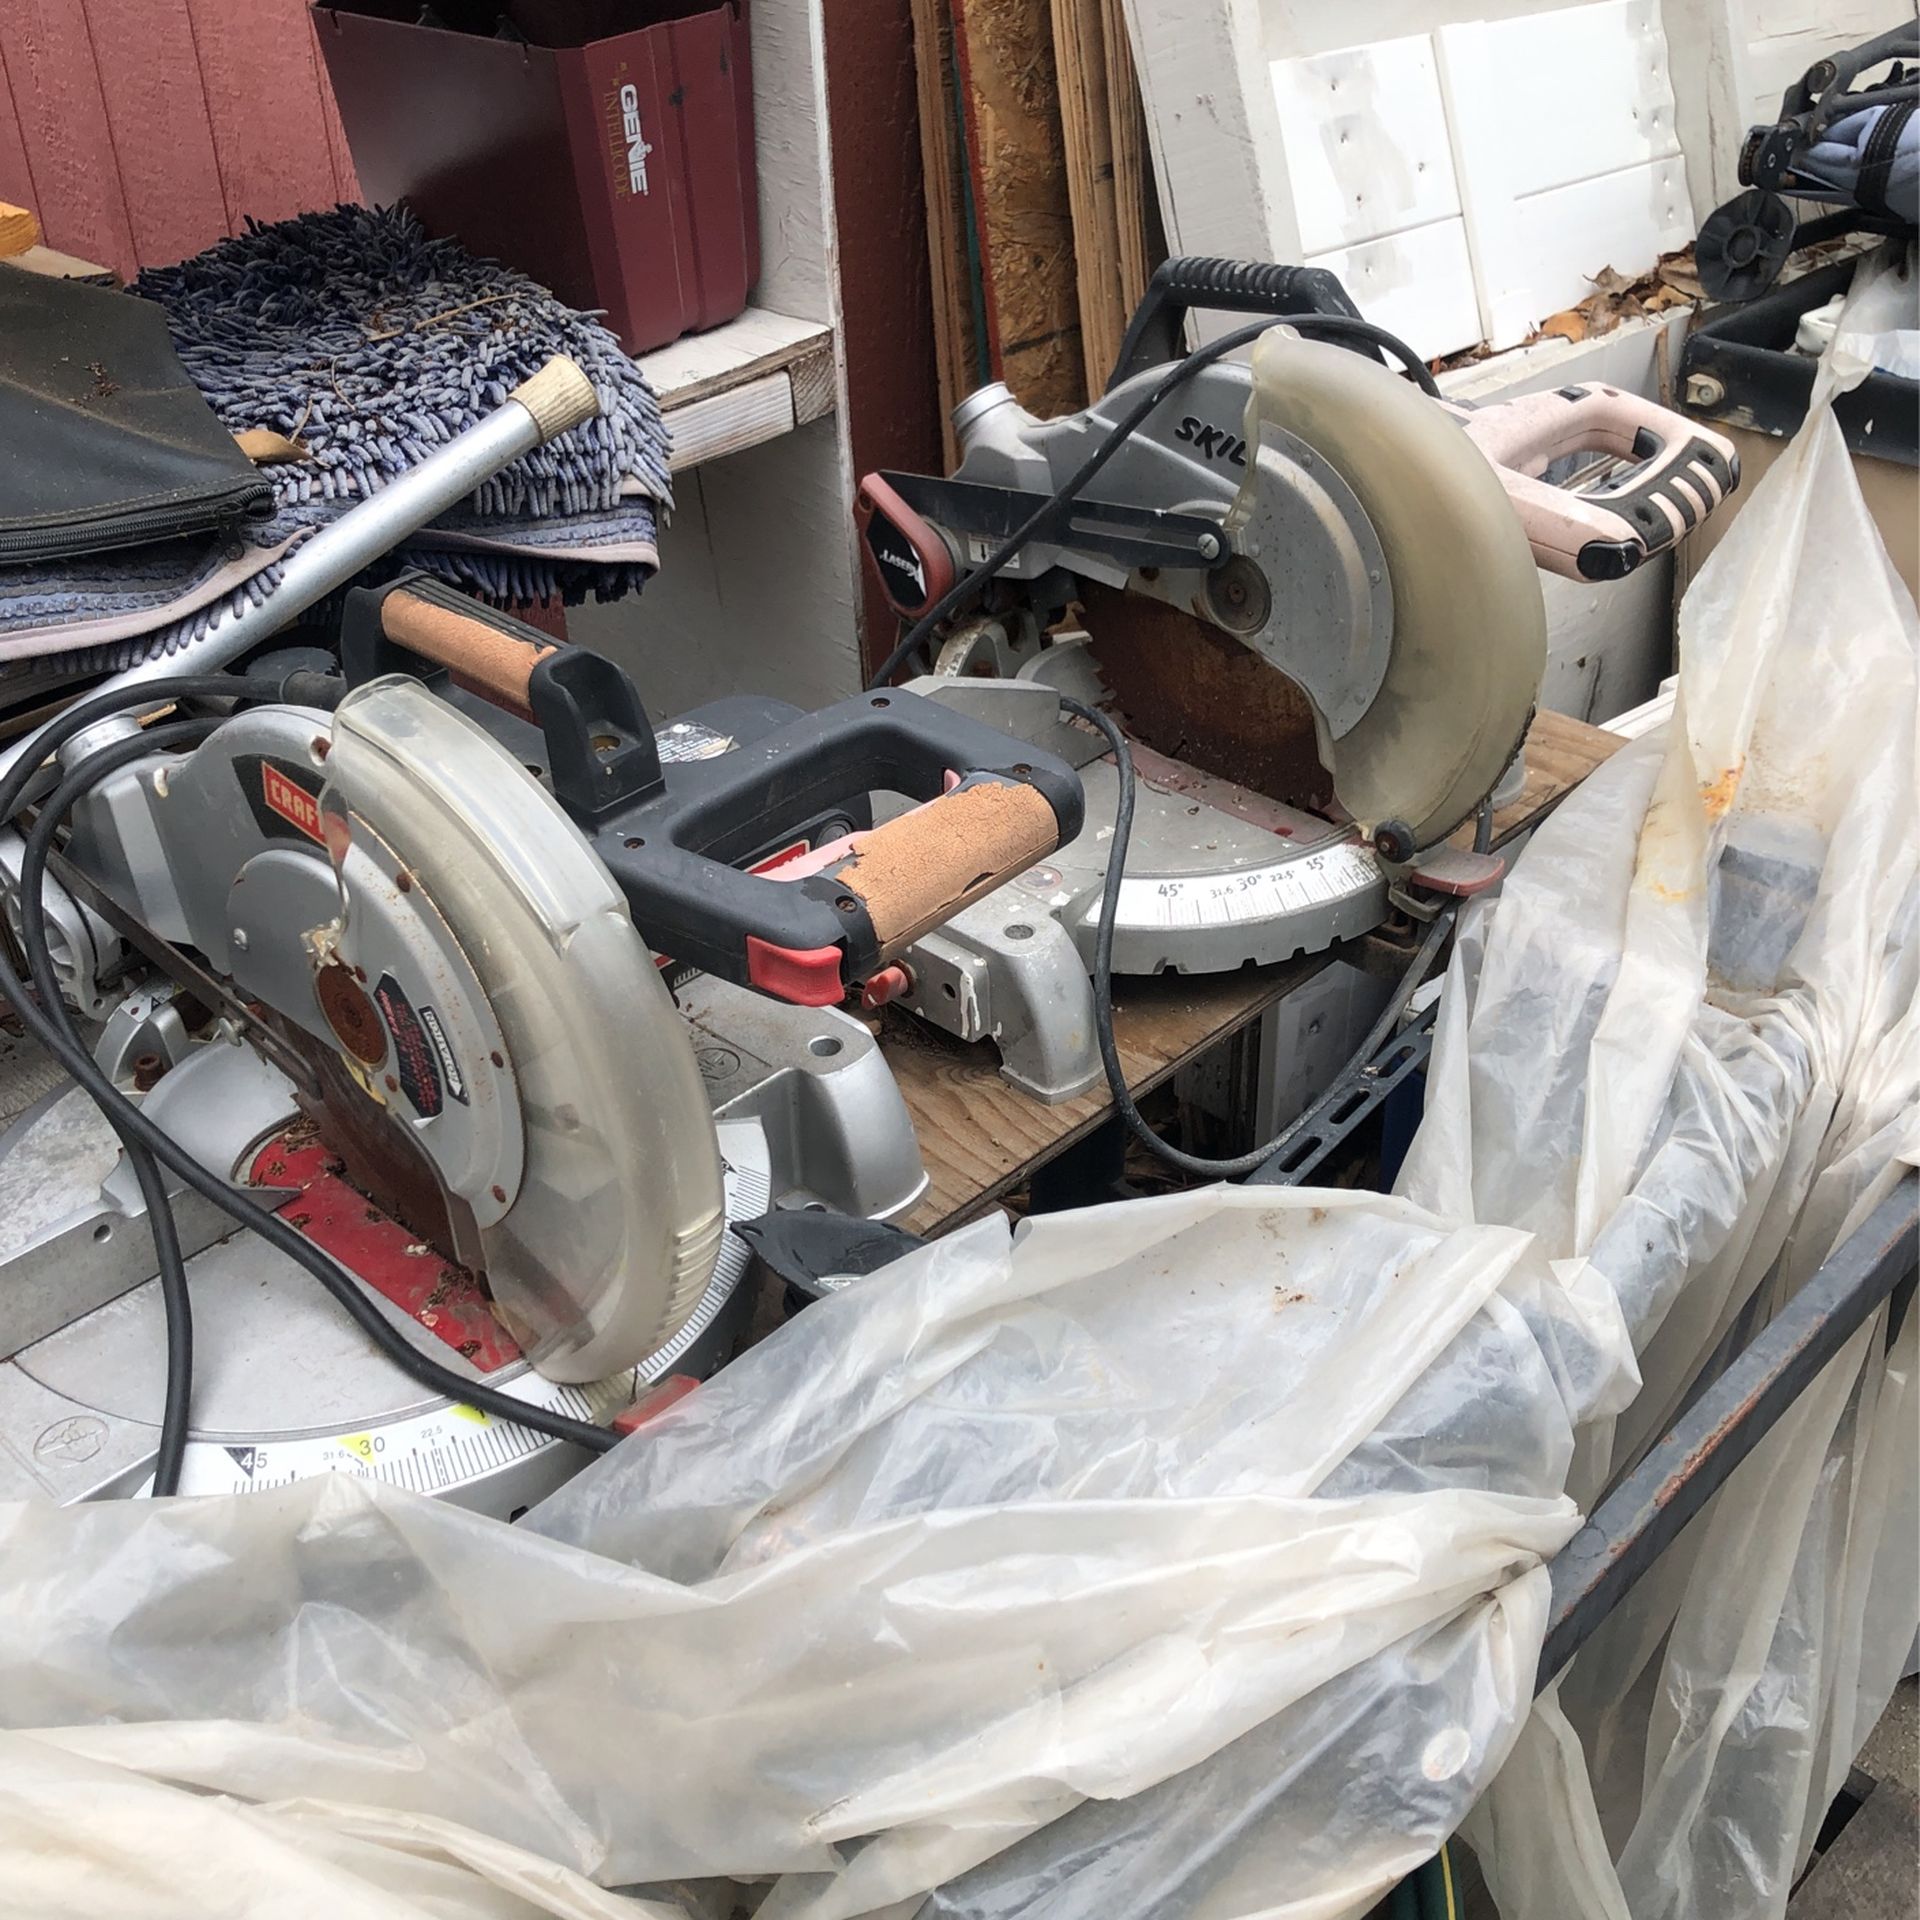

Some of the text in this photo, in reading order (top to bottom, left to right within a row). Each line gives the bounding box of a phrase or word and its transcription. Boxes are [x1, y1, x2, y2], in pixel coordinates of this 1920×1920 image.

[620, 84, 649, 195] GENIE
[1174, 416, 1246, 467] SKIL
[270, 779, 320, 827] CRAF
[1158, 883, 1184, 898] 45°
[1236, 874, 1263, 892] 30°
[240, 1452, 268, 1469] 45
[359, 1436, 386, 1456] 30
